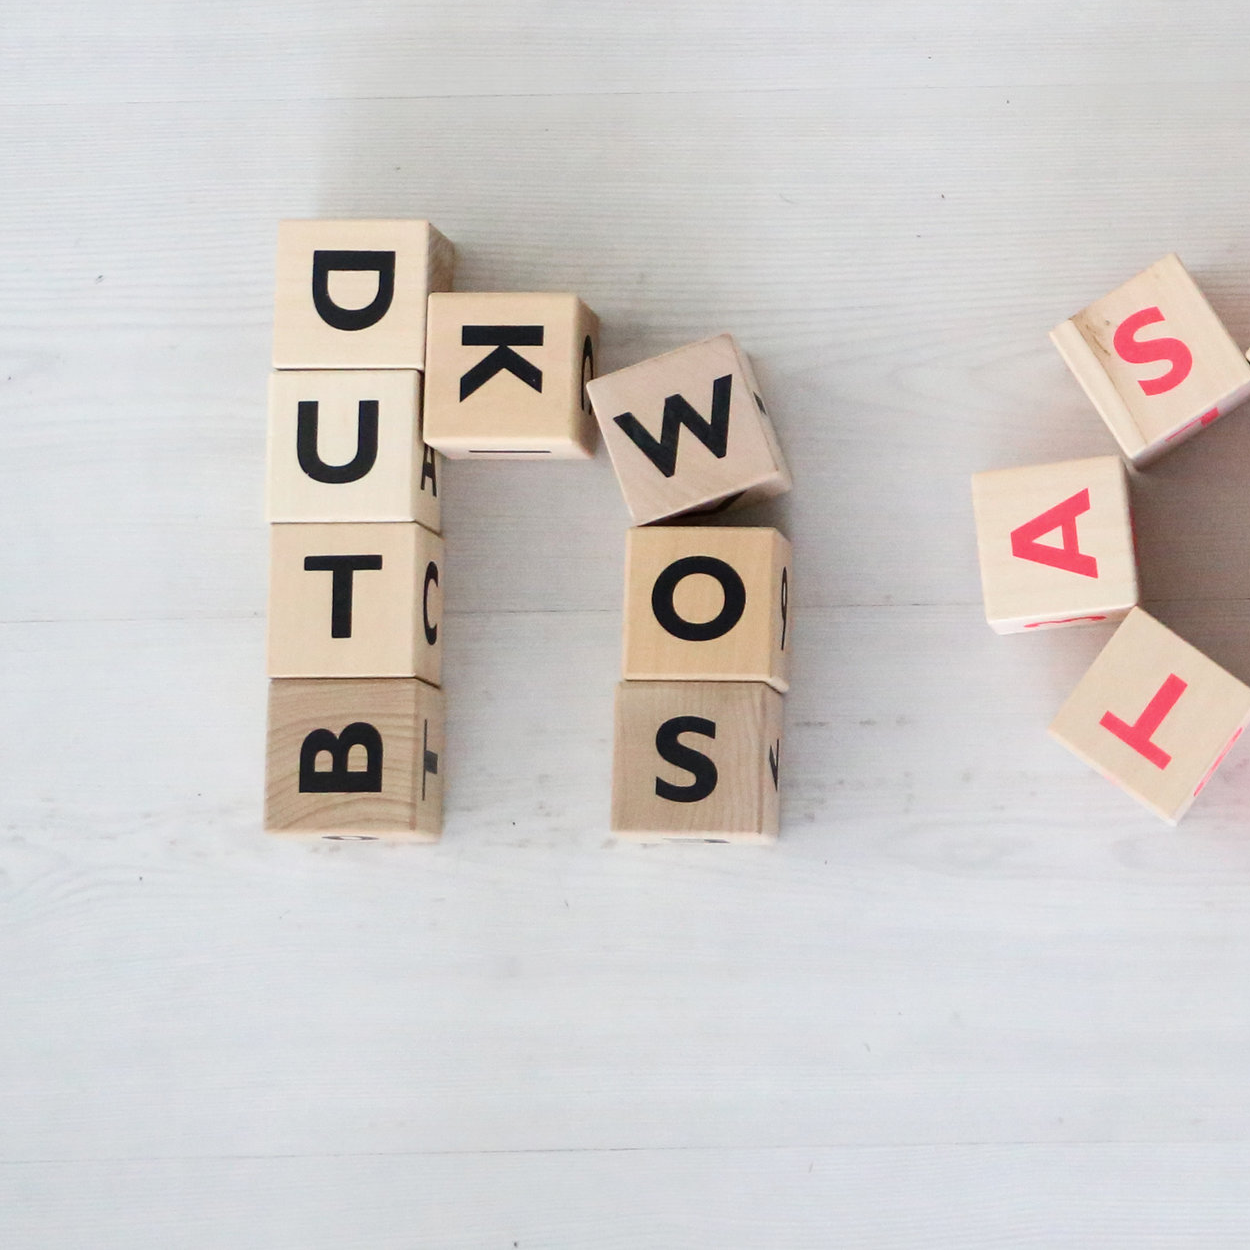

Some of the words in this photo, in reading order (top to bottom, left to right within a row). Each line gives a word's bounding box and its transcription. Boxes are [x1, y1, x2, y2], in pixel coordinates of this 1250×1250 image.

[313, 251, 395, 331] D
[460, 326, 543, 402] K
[1113, 307, 1192, 396] S
[297, 401, 378, 484] U
[613, 374, 732, 478] W
[1011, 488, 1098, 578] A
[304, 555, 382, 638] T
[652, 556, 746, 641] O
[299, 722, 383, 793] B
[656, 716, 718, 802] S
[1100, 674, 1187, 769] T
